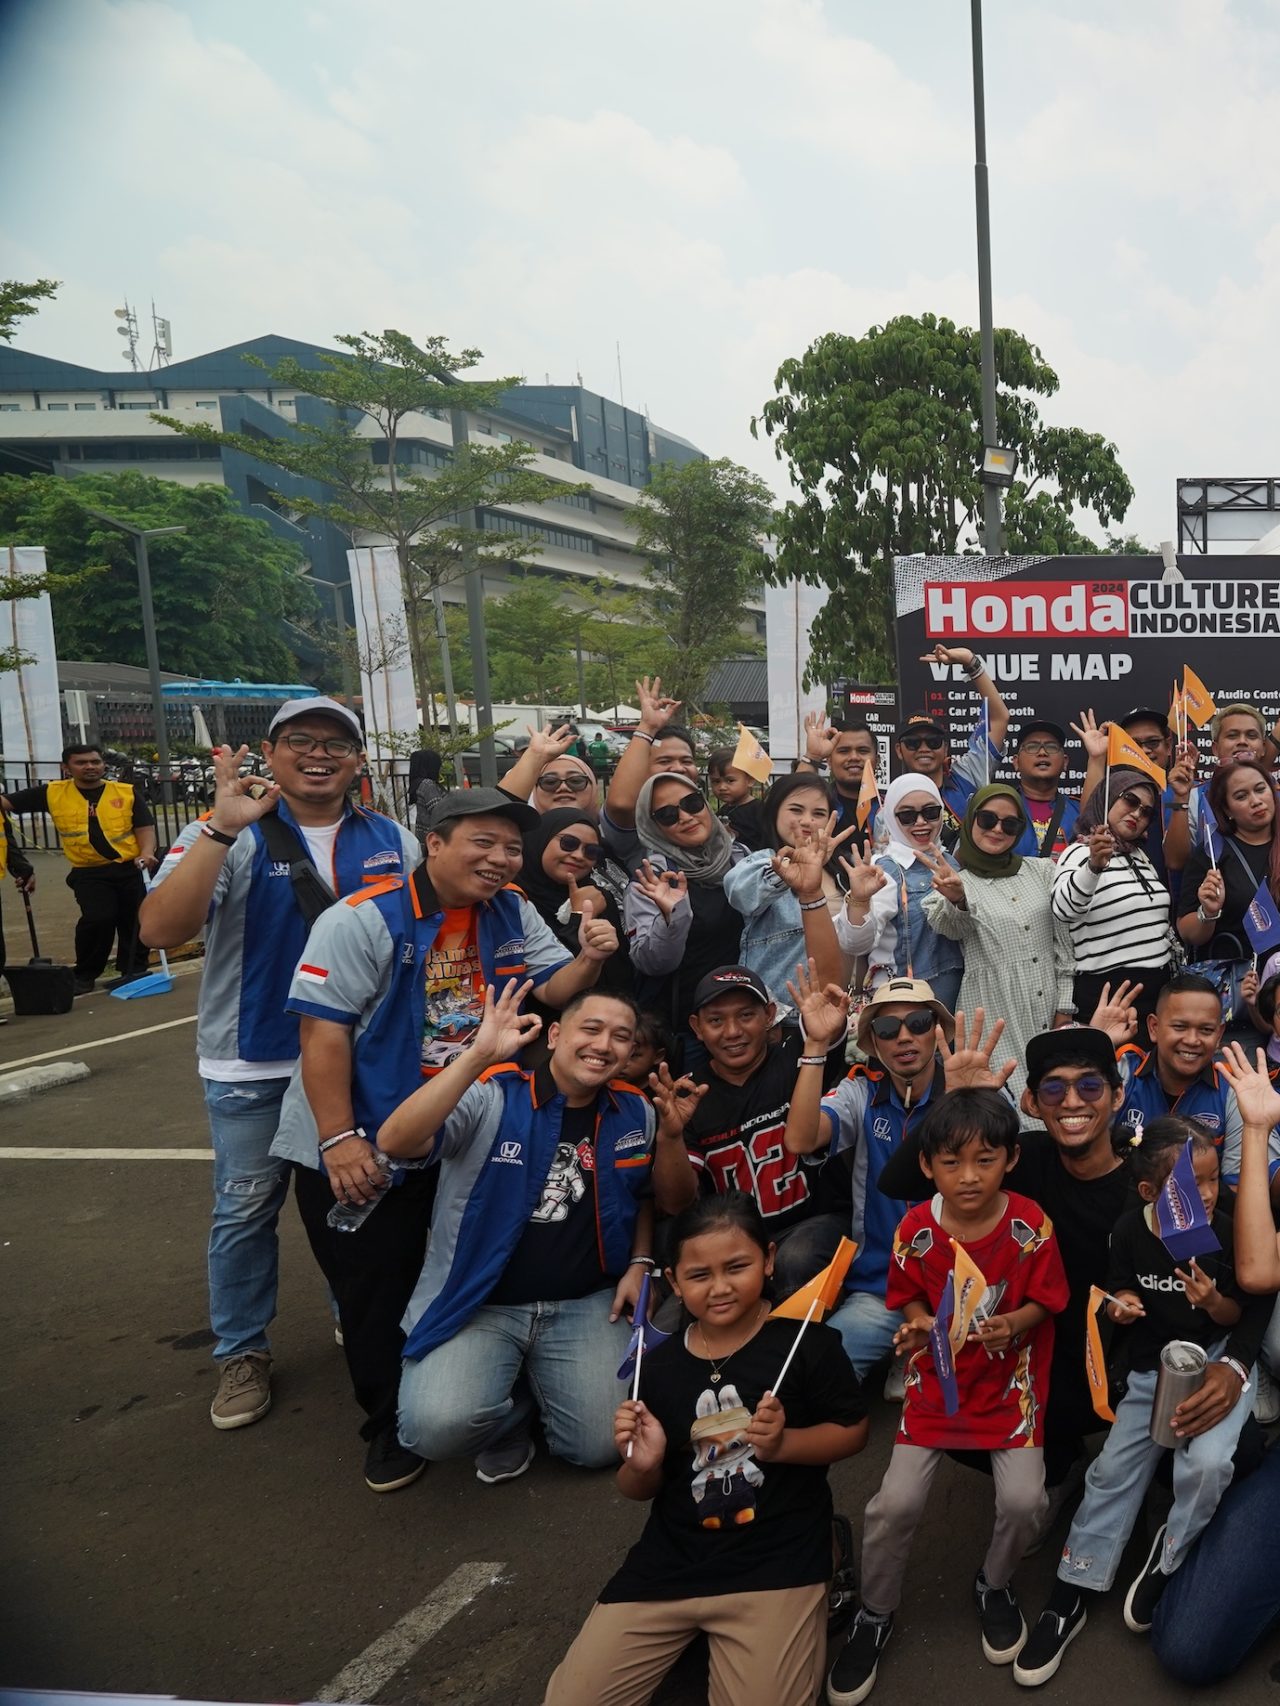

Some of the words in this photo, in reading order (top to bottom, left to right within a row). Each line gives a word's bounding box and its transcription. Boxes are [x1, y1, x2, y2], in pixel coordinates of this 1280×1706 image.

[1092, 584, 1123, 593] 2024
[1130, 583, 1280, 609] CULTURE
[927, 585, 1125, 633] Honda
[1131, 613, 1280, 633] INDONESIA
[1051, 654, 1133, 681] MAP
[948, 691, 966, 700] Car
[1217, 690, 1251, 699] Audio
[949, 707, 966, 716] Car
[1262, 706, 1280, 715] Car
[865, 713, 879, 721] CAR
[491, 1156, 524, 1166] HONDA
[1136, 1274, 1187, 1292] dida
